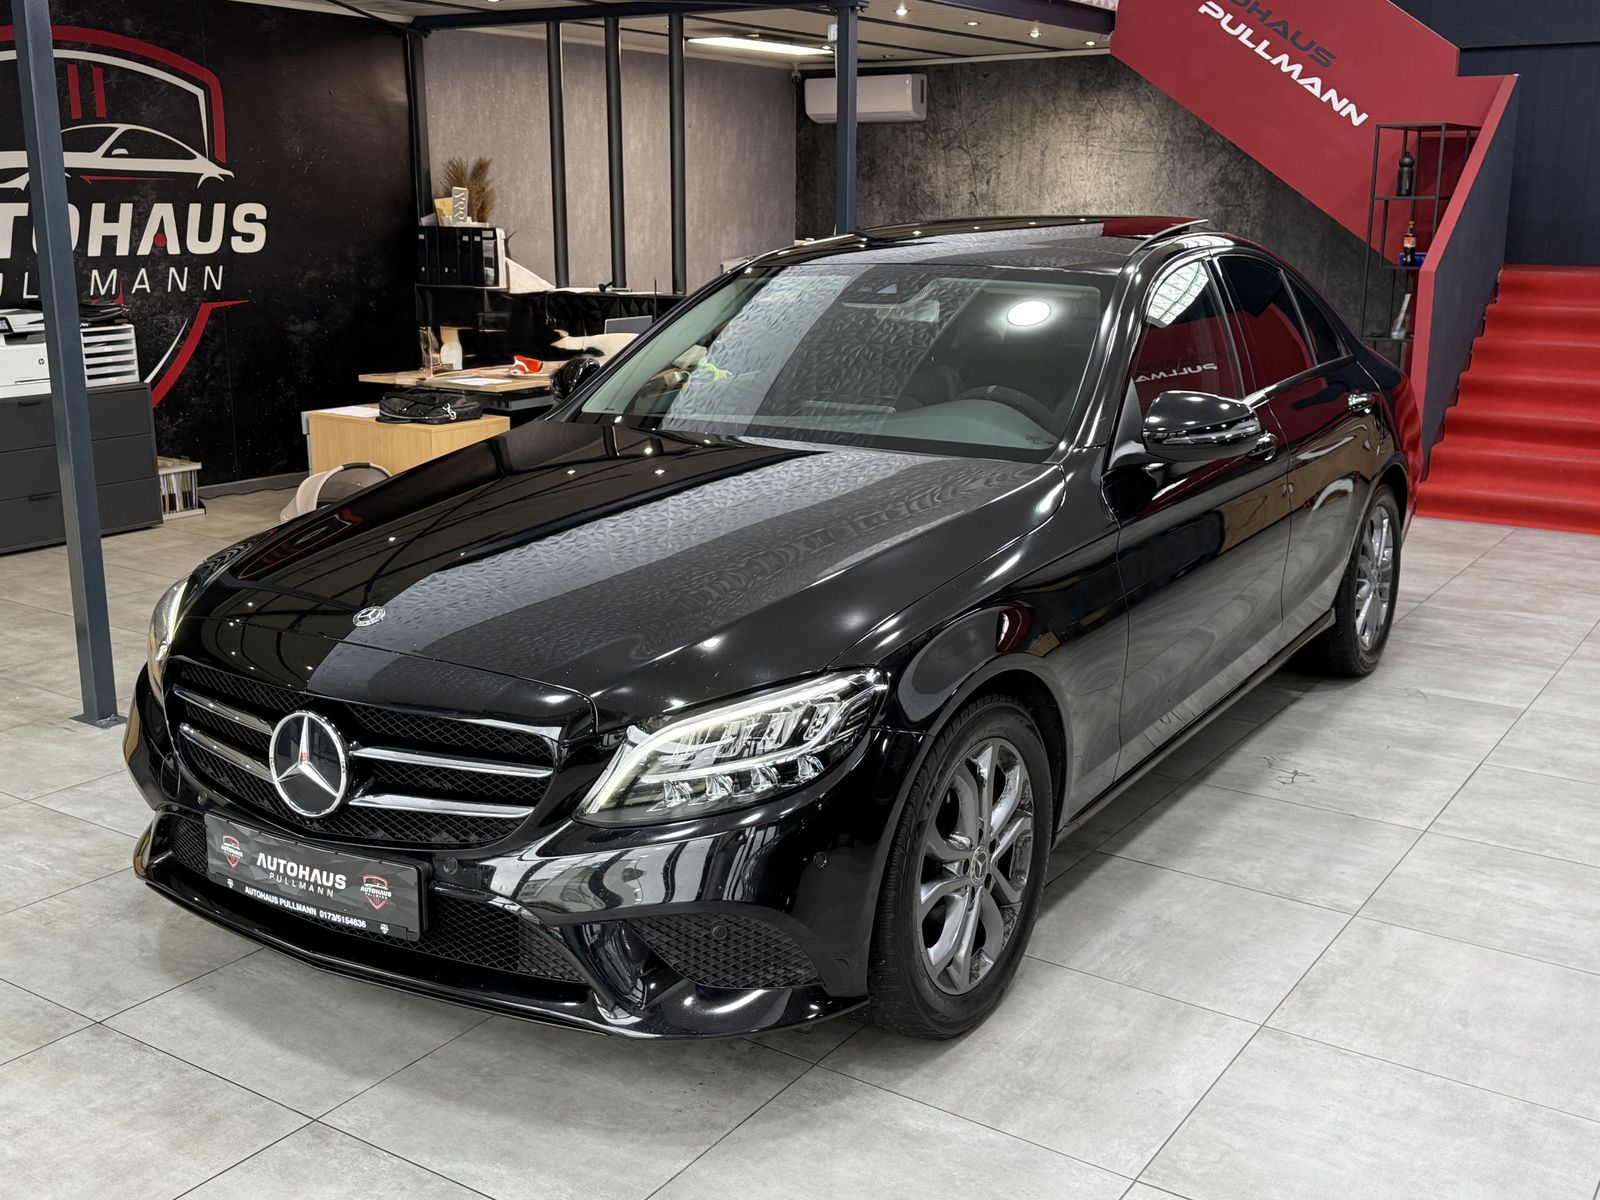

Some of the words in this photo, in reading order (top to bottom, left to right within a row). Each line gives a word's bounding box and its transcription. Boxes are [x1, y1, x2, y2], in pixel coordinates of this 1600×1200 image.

[1231, 0, 1336, 68] HAUS
[1198, 1, 1369, 127] PULLMANN
[0, 265, 223, 299] LMANN
[256, 852, 347, 890] AUTOHAUS
[269, 872, 334, 898] PULLMANN
[245, 886, 279, 905] AUTOHAUS
[279, 898, 317, 916] PULLMANN
[360, 885, 392, 897] AUTOHAUS
